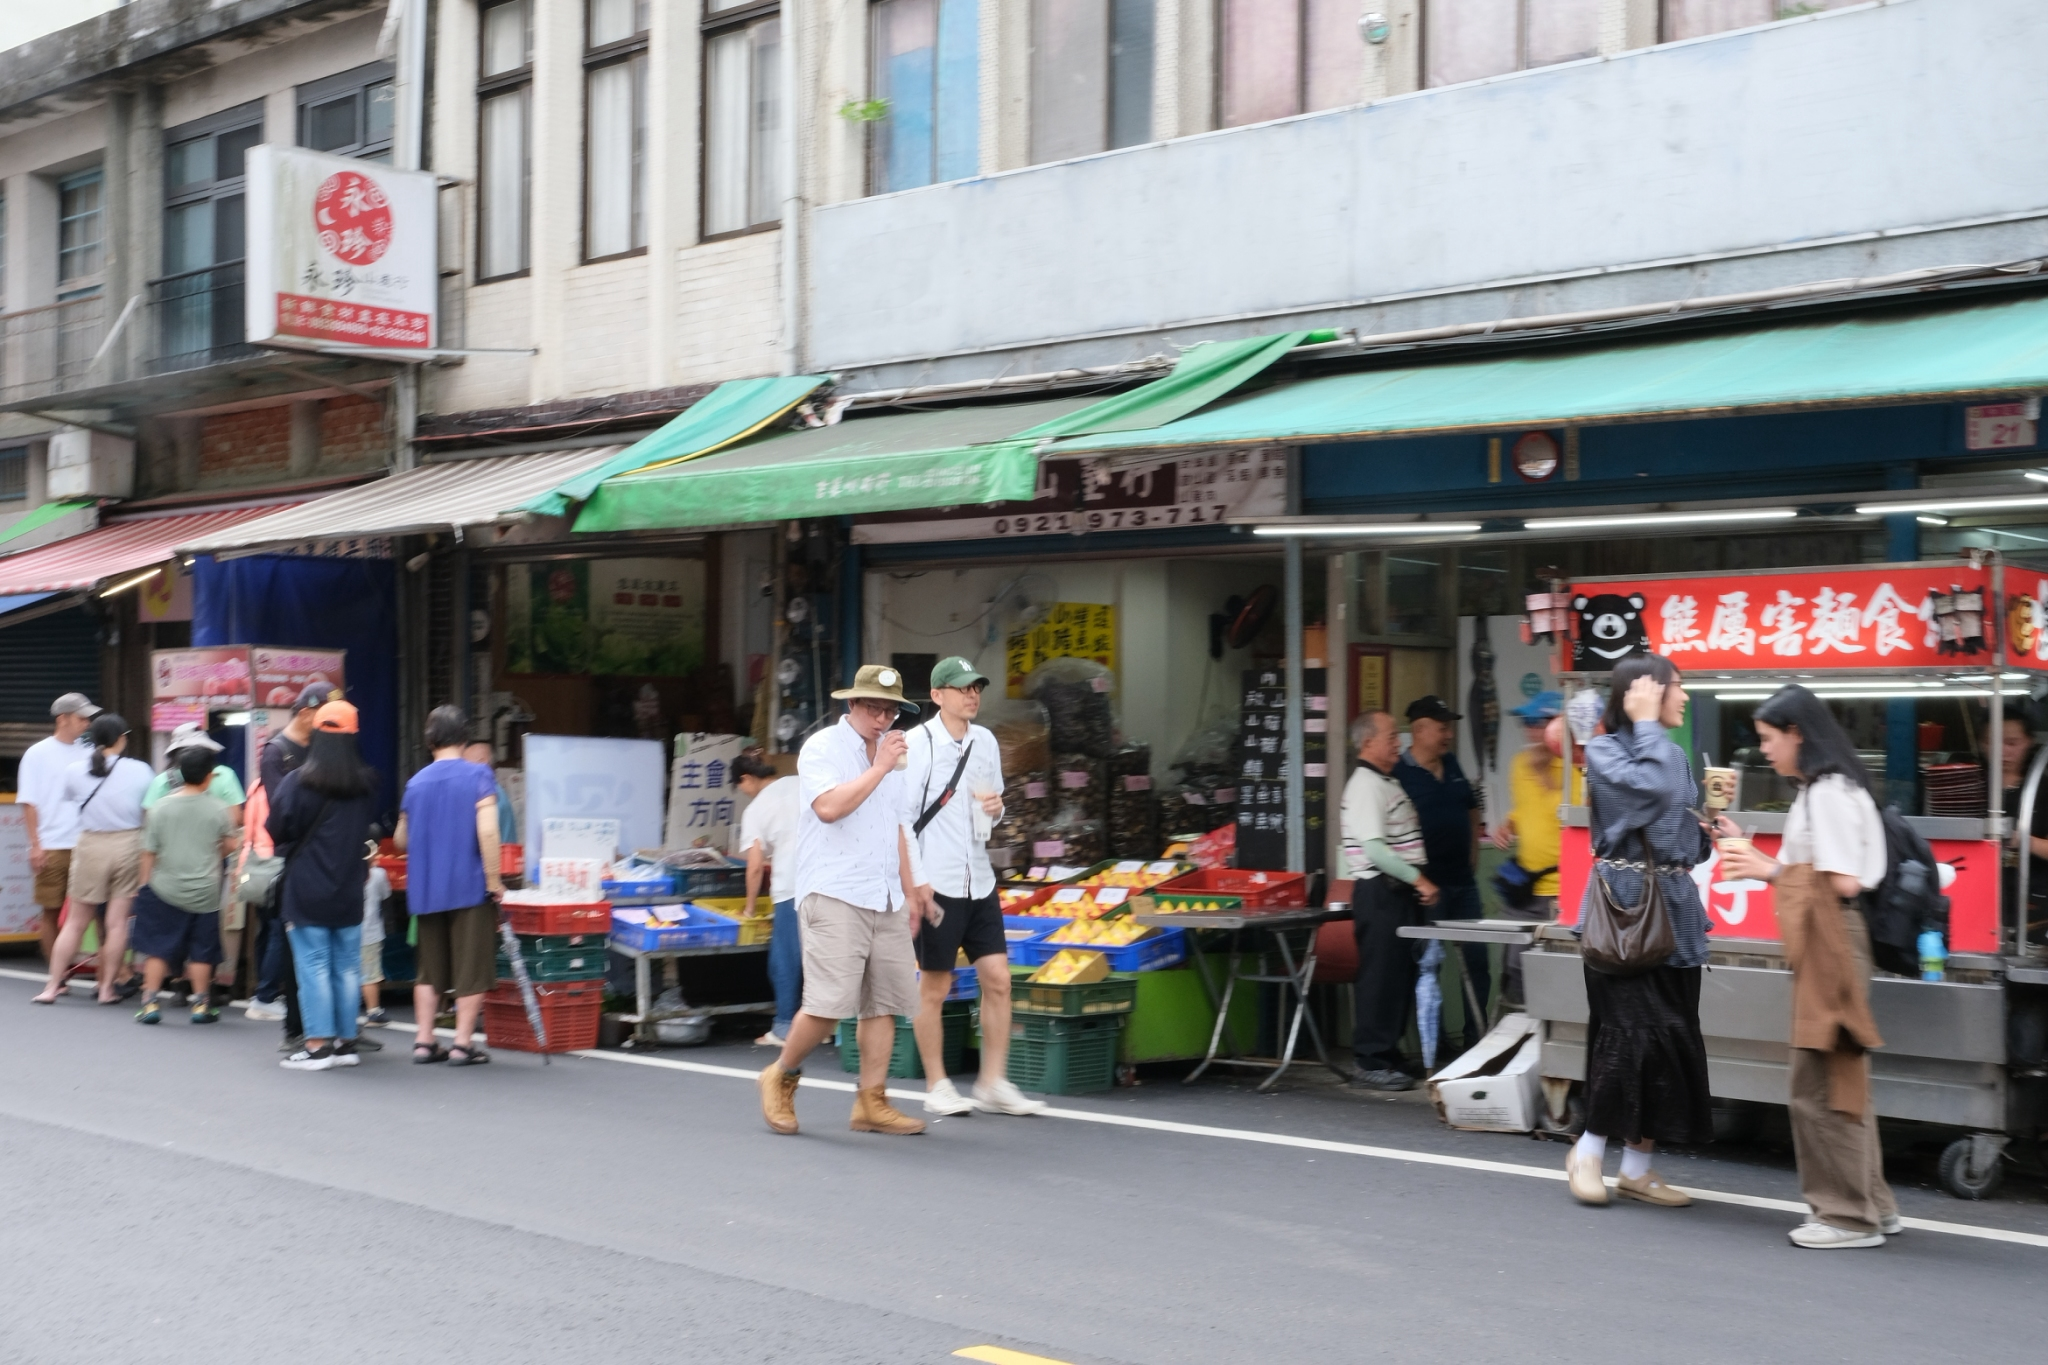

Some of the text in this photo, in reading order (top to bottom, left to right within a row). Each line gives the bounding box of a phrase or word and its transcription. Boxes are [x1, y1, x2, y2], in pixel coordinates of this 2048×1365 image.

[994, 503, 1228, 535] 0921973-717
[679, 758, 731, 789] 主會
[687, 796, 734, 828] 方向
